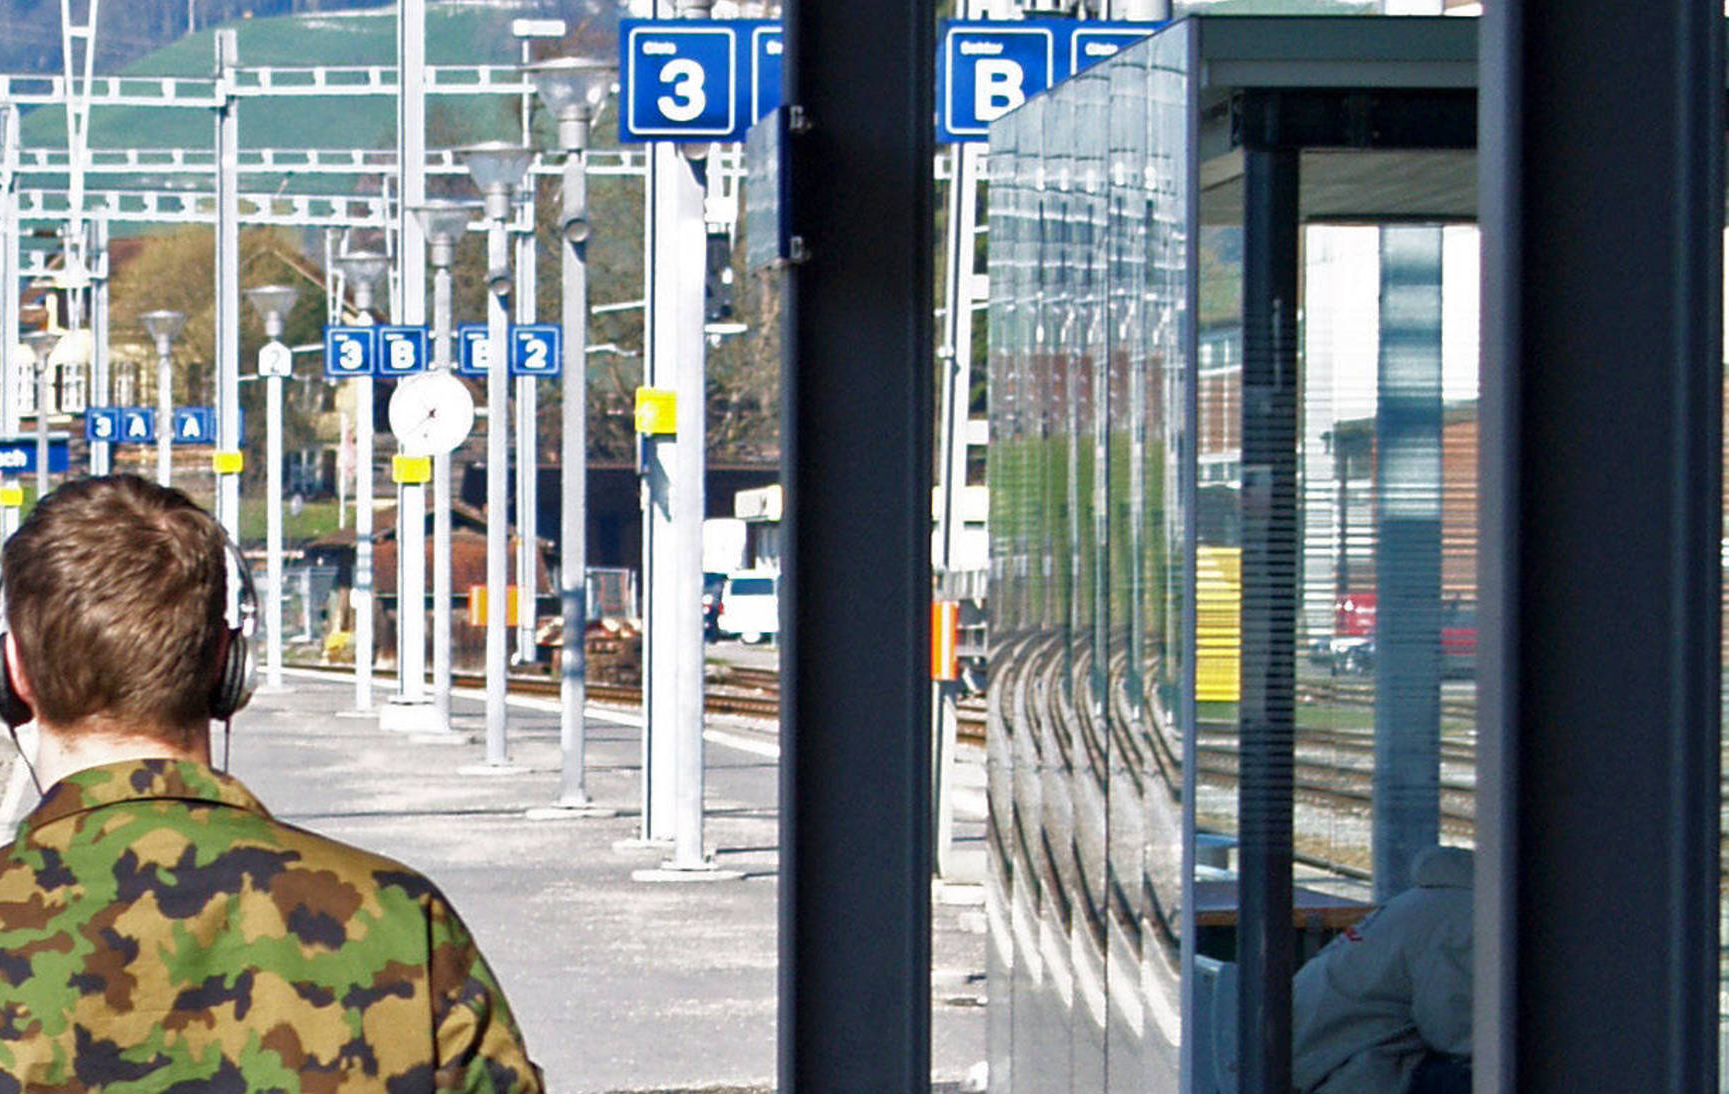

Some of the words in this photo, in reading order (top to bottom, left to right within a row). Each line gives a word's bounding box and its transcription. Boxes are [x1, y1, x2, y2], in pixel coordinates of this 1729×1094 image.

[656, 58, 707, 122] 3
[974, 58, 1026, 122] B
[339, 340, 363, 370] 3
[390, 340, 415, 369] B
[525, 339, 548, 368] 2
[96, 417, 112, 437] 3
[129, 416, 147, 437] A
[182, 416, 200, 437] A
